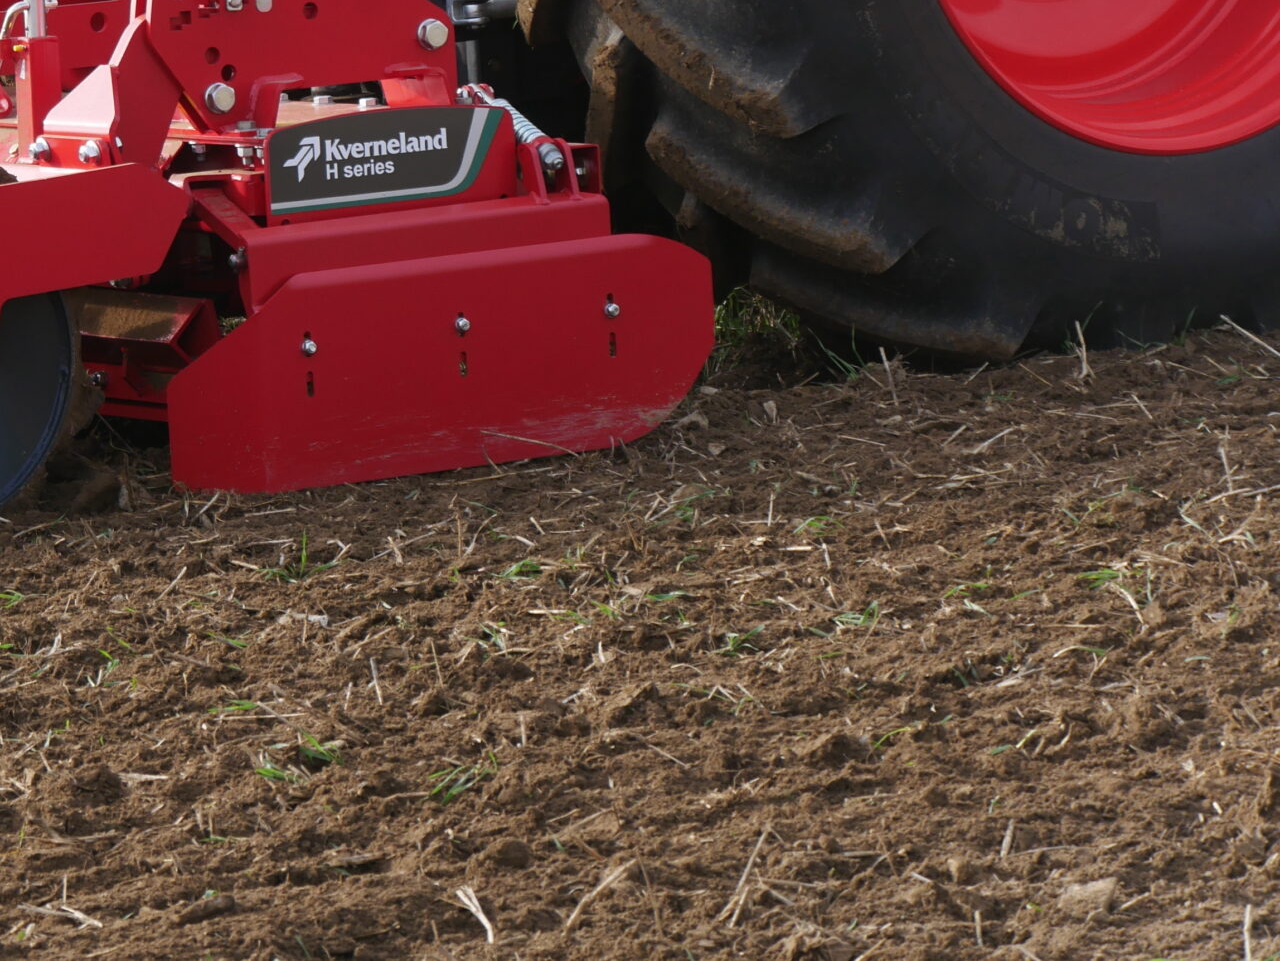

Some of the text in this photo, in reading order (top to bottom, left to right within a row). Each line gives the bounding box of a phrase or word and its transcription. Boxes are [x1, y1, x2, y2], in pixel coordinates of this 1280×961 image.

[324, 127, 448, 161] Kverneland
[326, 159, 395, 181] H series
